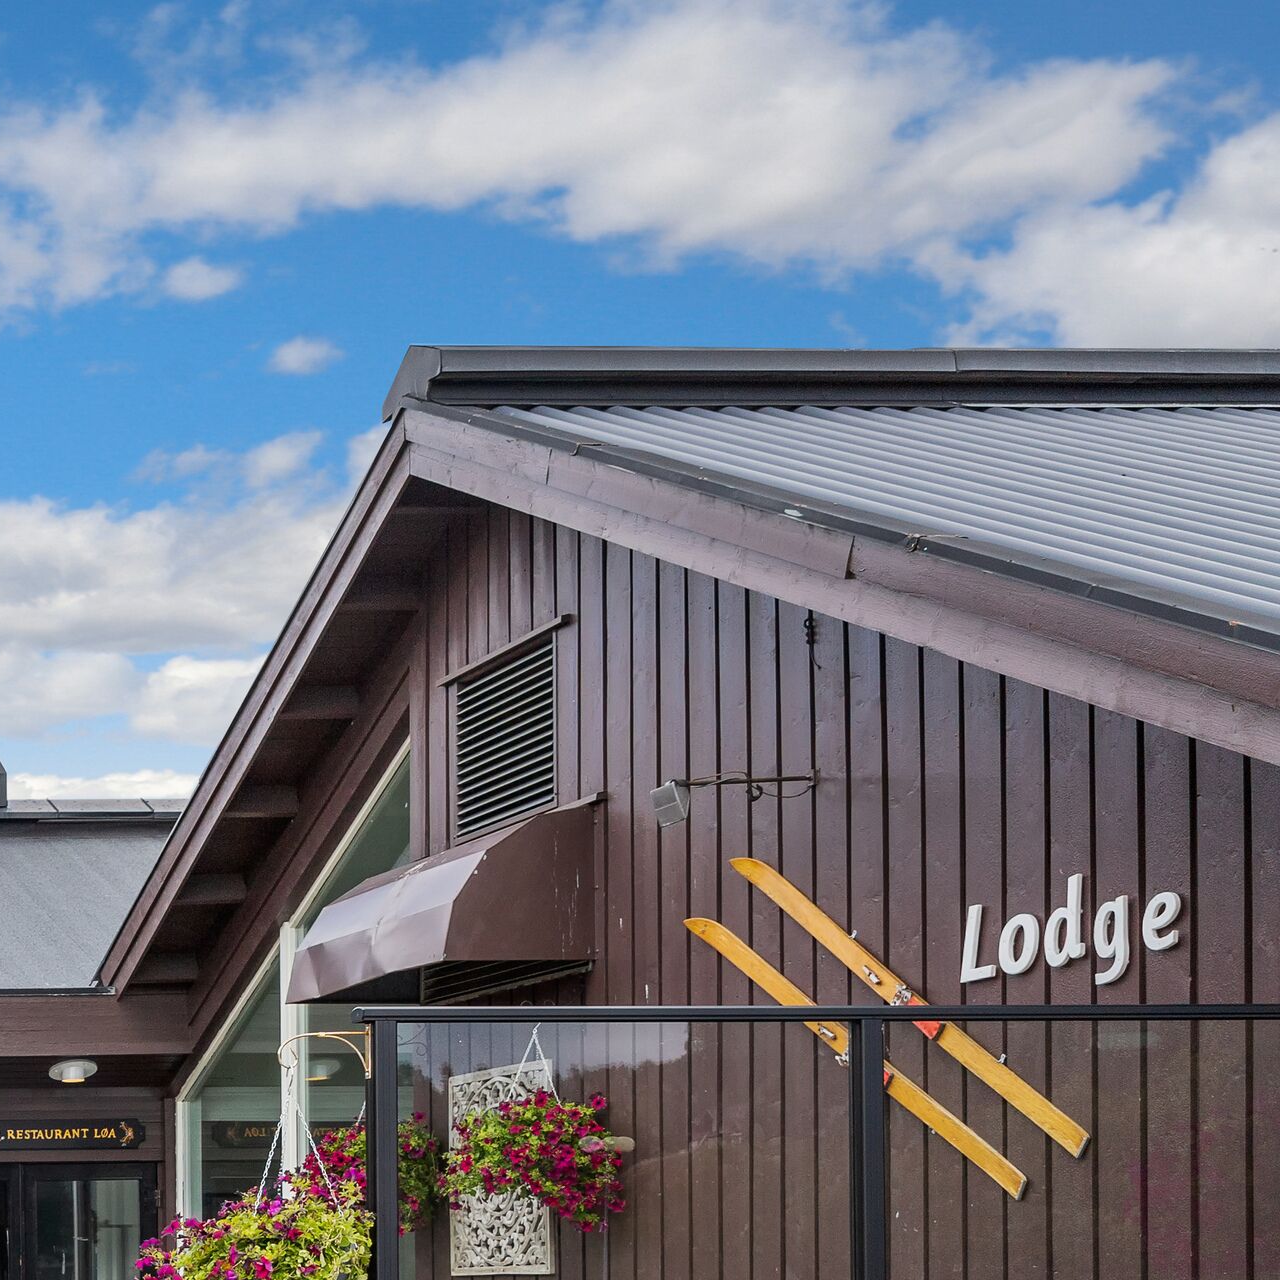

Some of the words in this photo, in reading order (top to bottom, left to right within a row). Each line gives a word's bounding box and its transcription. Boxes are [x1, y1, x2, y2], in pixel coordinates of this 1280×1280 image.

[959, 872, 1183, 986] Lodge
[6, 1127, 90, 1140] RESTAURANT
[93, 1127, 118, 1140] LØA
